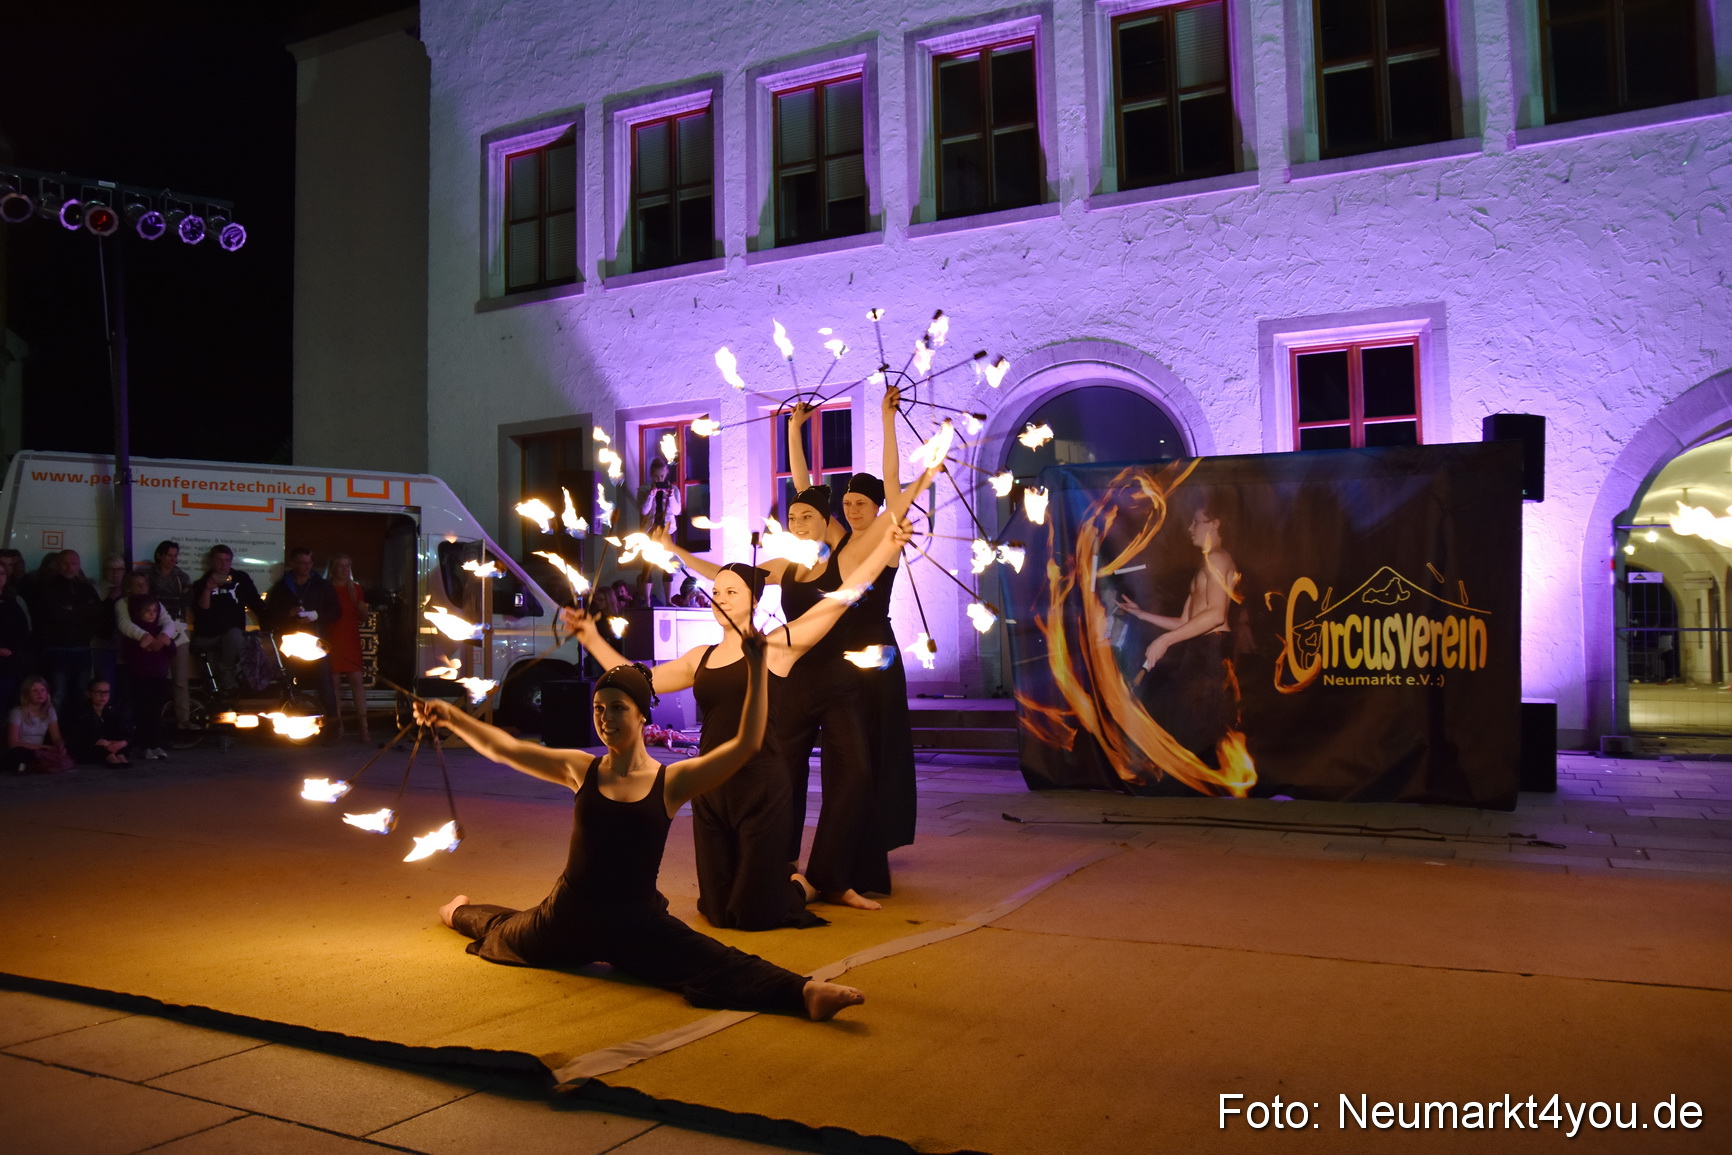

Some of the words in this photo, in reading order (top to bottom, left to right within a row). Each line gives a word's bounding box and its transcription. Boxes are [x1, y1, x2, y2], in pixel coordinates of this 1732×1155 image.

[31, 470, 316, 496] www.pe-konferenztechnik.de
[1286, 577, 1488, 683] Circusverein
[1323, 674, 1402, 686] Neumarkt
[1406, 674, 1434, 686] e.V.
